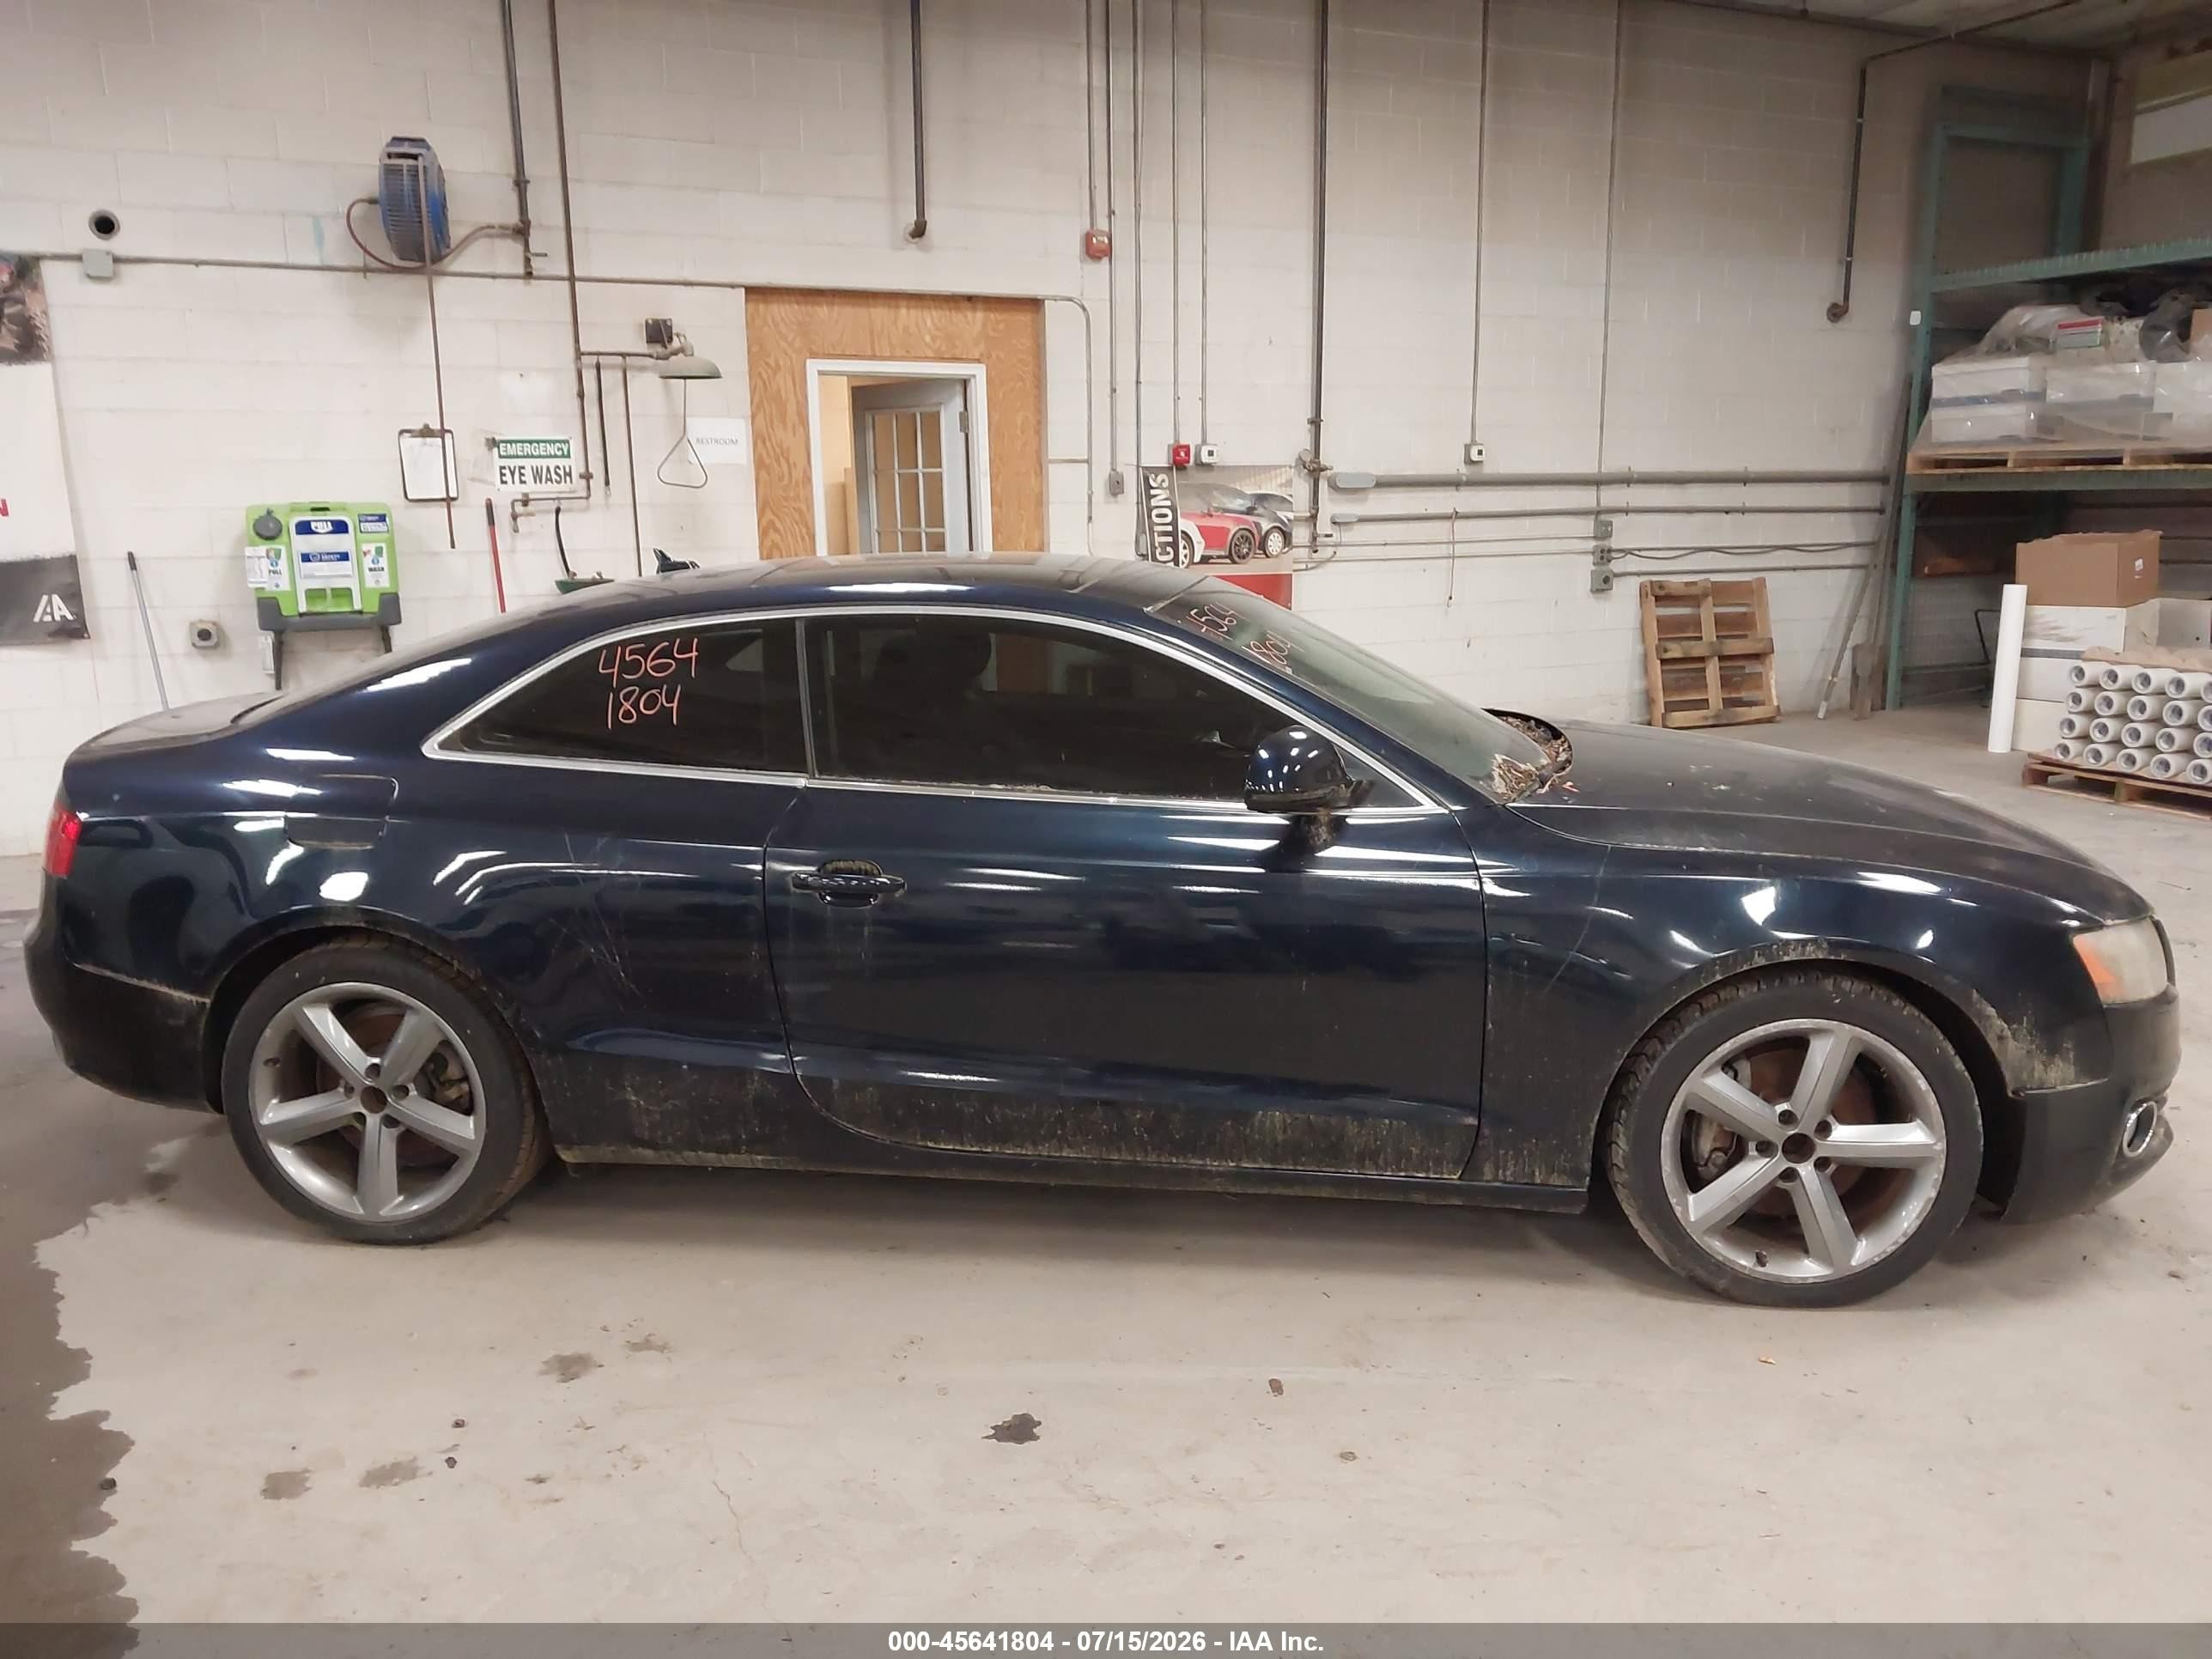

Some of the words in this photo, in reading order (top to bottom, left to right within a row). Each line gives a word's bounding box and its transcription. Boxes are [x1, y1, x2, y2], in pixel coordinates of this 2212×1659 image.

[499, 442, 569, 456] EMERGENCY
[695, 437, 739, 446] RESTROOM
[499, 465, 526, 484] EYE
[531, 465, 573, 484] WASH
[1148, 473, 1176, 567] CTIONS
[599, 637, 699, 689] 4564
[607, 684, 682, 730] 1804
